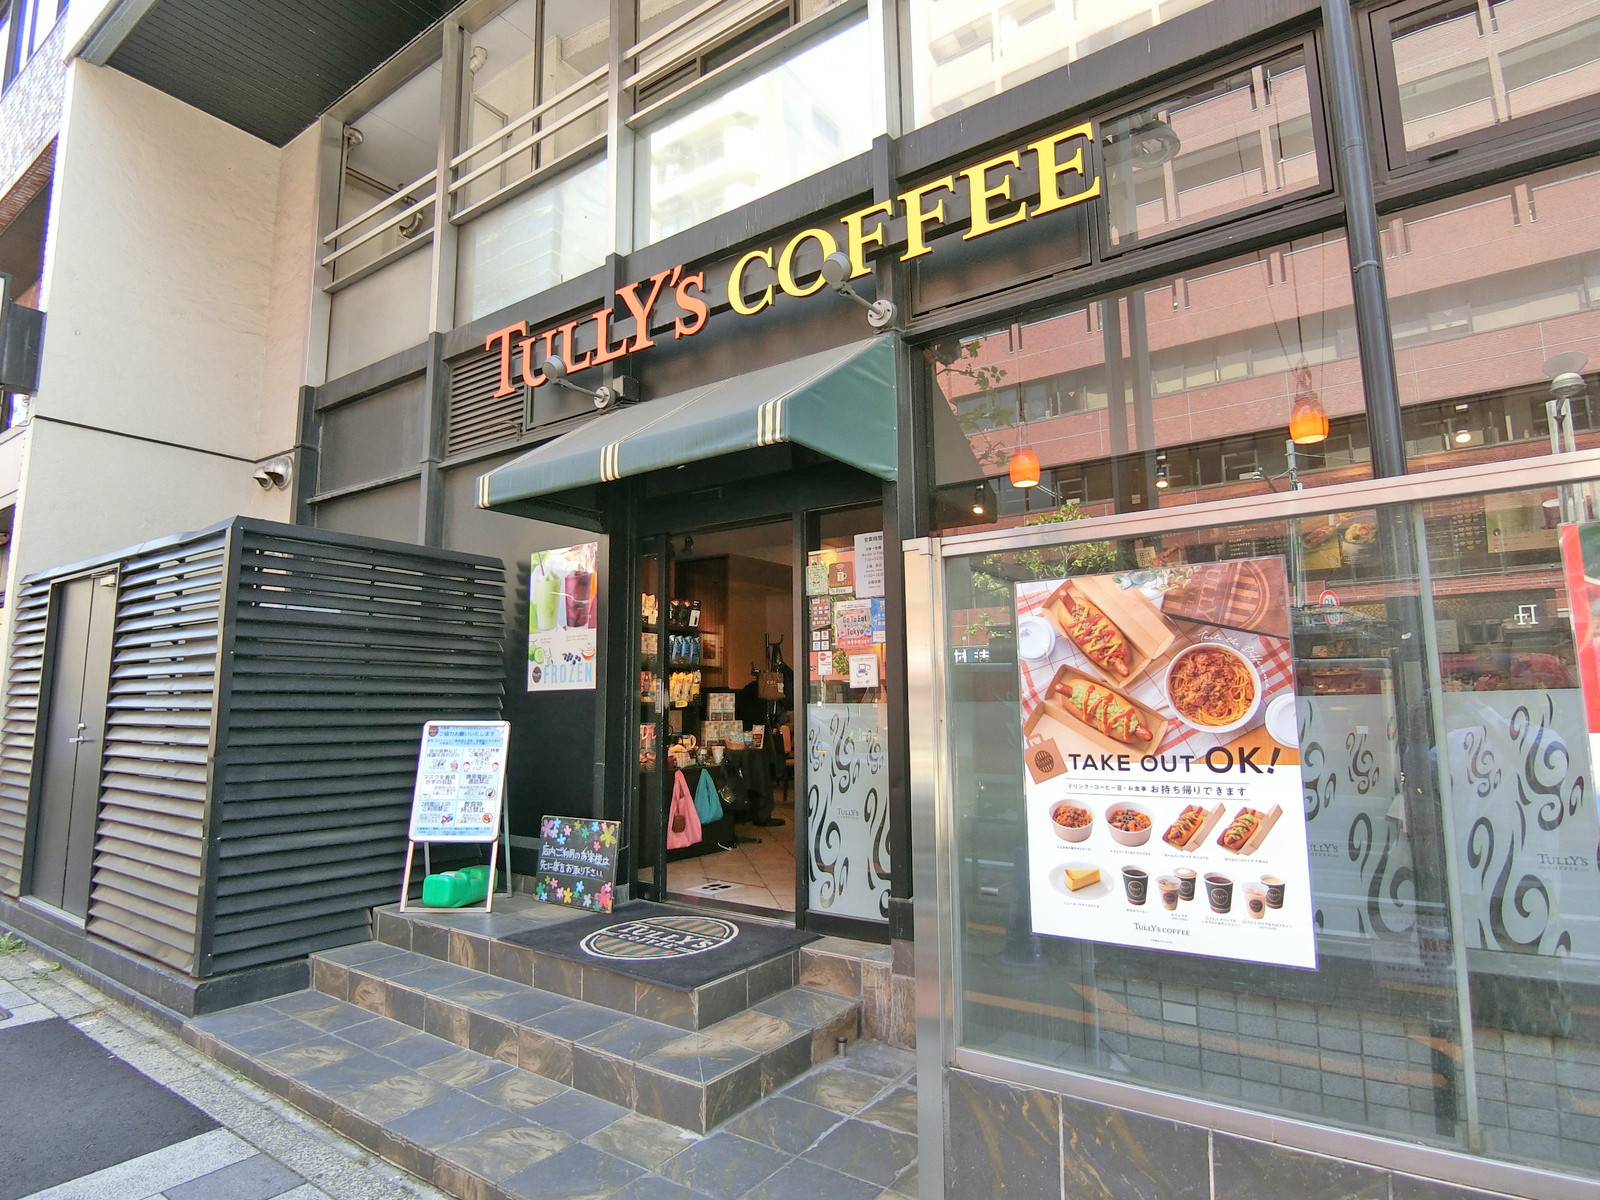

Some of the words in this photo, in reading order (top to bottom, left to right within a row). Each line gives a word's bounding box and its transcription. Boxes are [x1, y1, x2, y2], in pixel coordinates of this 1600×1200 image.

[485, 264, 709, 400] TULLY'S
[727, 121, 1102, 316] COFFEE
[543, 663, 593, 684] FROZEN
[1068, 753, 1131, 772] TAKE
[1140, 754, 1194, 773] OUT
[1205, 746, 1281, 774] OK!
[1150, 784, 1247, 796] お持ち帰りできます
[1536, 853, 1588, 867] TULLY'S
[618, 923, 714, 949] TULLY'S
[1133, 922, 1161, 933] TULLY'S
[1162, 927, 1191, 936] COFFEE
[618, 934, 678, 949] COFFEE
